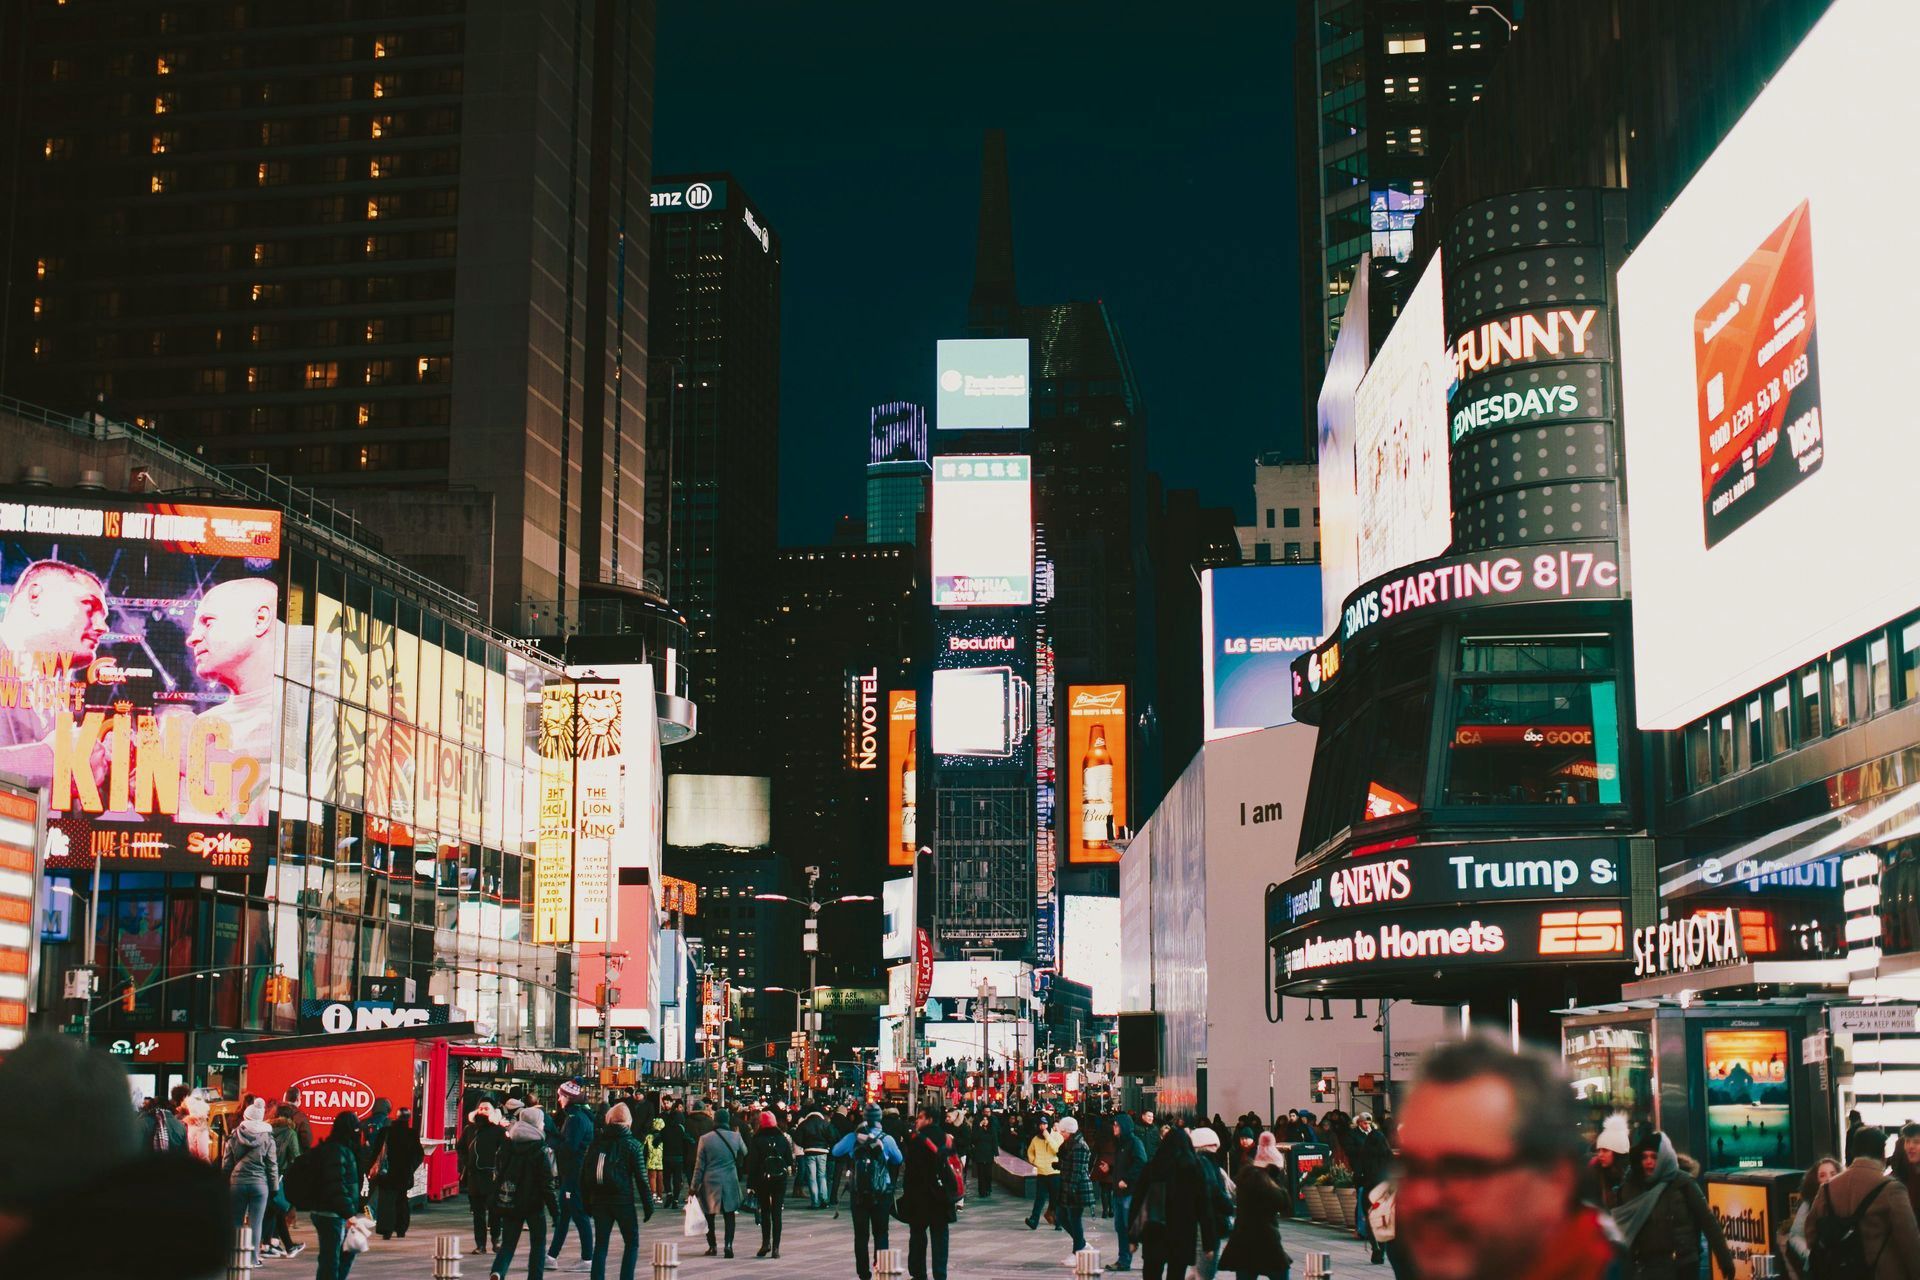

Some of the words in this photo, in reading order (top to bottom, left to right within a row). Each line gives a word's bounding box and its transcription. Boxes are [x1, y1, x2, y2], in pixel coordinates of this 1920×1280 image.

[1458, 310, 1597, 381] FUNNY
[1732, 401, 1754, 438] 1234
[1757, 377, 1780, 416] 5678
[1783, 353, 1808, 392] 9123
[1786, 407, 1821, 459] VISA
[105, 511, 120, 537] VS
[953, 579, 1012, 592] XINHUA
[1381, 557, 1521, 618] STARTING
[950, 636, 1015, 650] Beautiful
[1225, 637, 1246, 653] LG
[456, 689, 482, 729] THE
[860, 667, 877, 769] NOVOTEL
[1524, 732, 1544, 742] abc
[52, 710, 260, 815] KING?
[587, 788, 607, 798] THE
[582, 801, 611, 817] LION
[1240, 803, 1246, 825] I
[1251, 802, 1283, 824] am
[580, 820, 615, 840] KING
[91, 831, 116, 857] LIVE
[120, 831, 130, 857] &
[133, 832, 163, 859] FREE
[187, 832, 252, 858] Spike
[212, 853, 249, 867] SPORTS
[1341, 859, 1412, 908] NEWS
[1449, 855, 1580, 893] Trump
[1354, 930, 1376, 962] to
[1381, 920, 1505, 960] Hornets
[1538, 909, 1624, 955] ES
[1633, 906, 1740, 977] SEPHORA
[1840, 1009, 1878, 1019] PEDESTRIAN
[1880, 1009, 1896, 1018] FLOW
[1874, 1020, 1889, 1029] KEEP
[300, 1090, 371, 1108] TRAND
